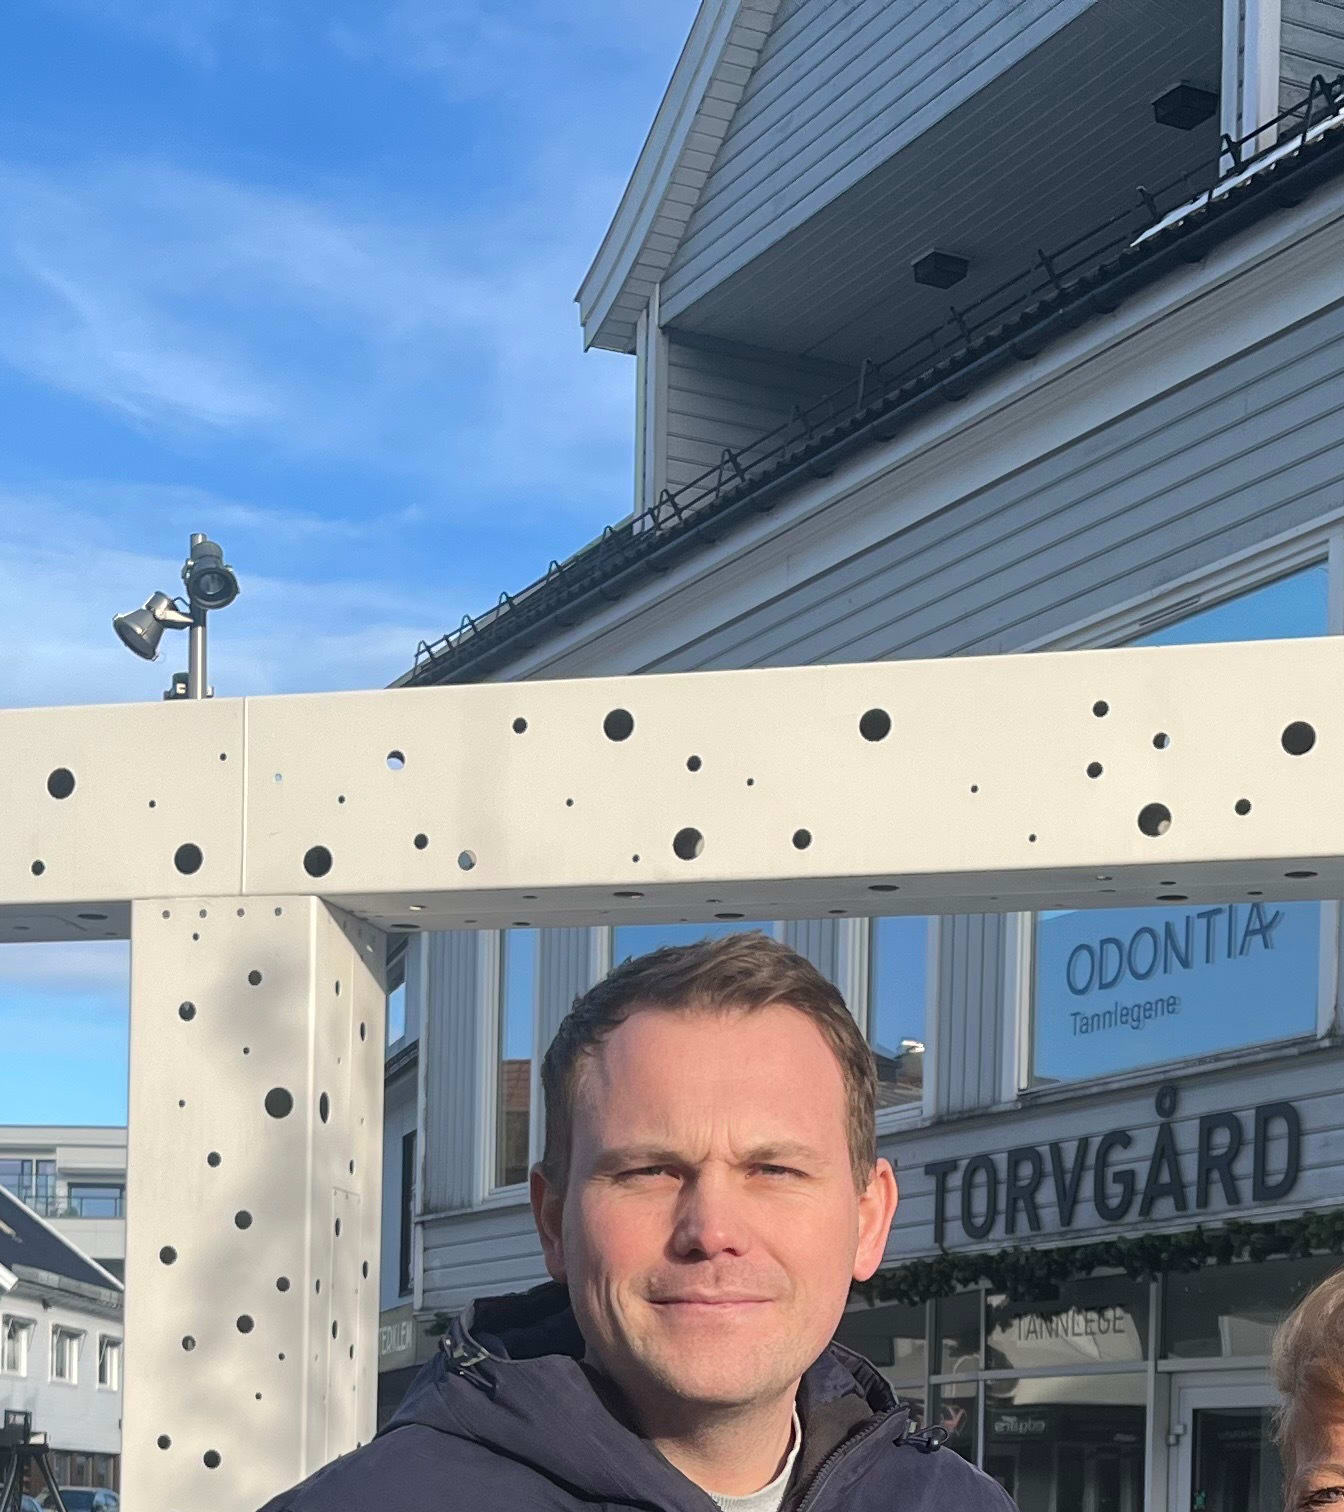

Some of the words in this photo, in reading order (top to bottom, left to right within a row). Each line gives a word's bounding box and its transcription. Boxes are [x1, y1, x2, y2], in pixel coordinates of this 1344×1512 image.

[1065, 902, 1284, 997] ODONTIA
[1069, 994, 1178, 1037] Tannlegene
[924, 1085, 1301, 1244] TORVGÅRD
